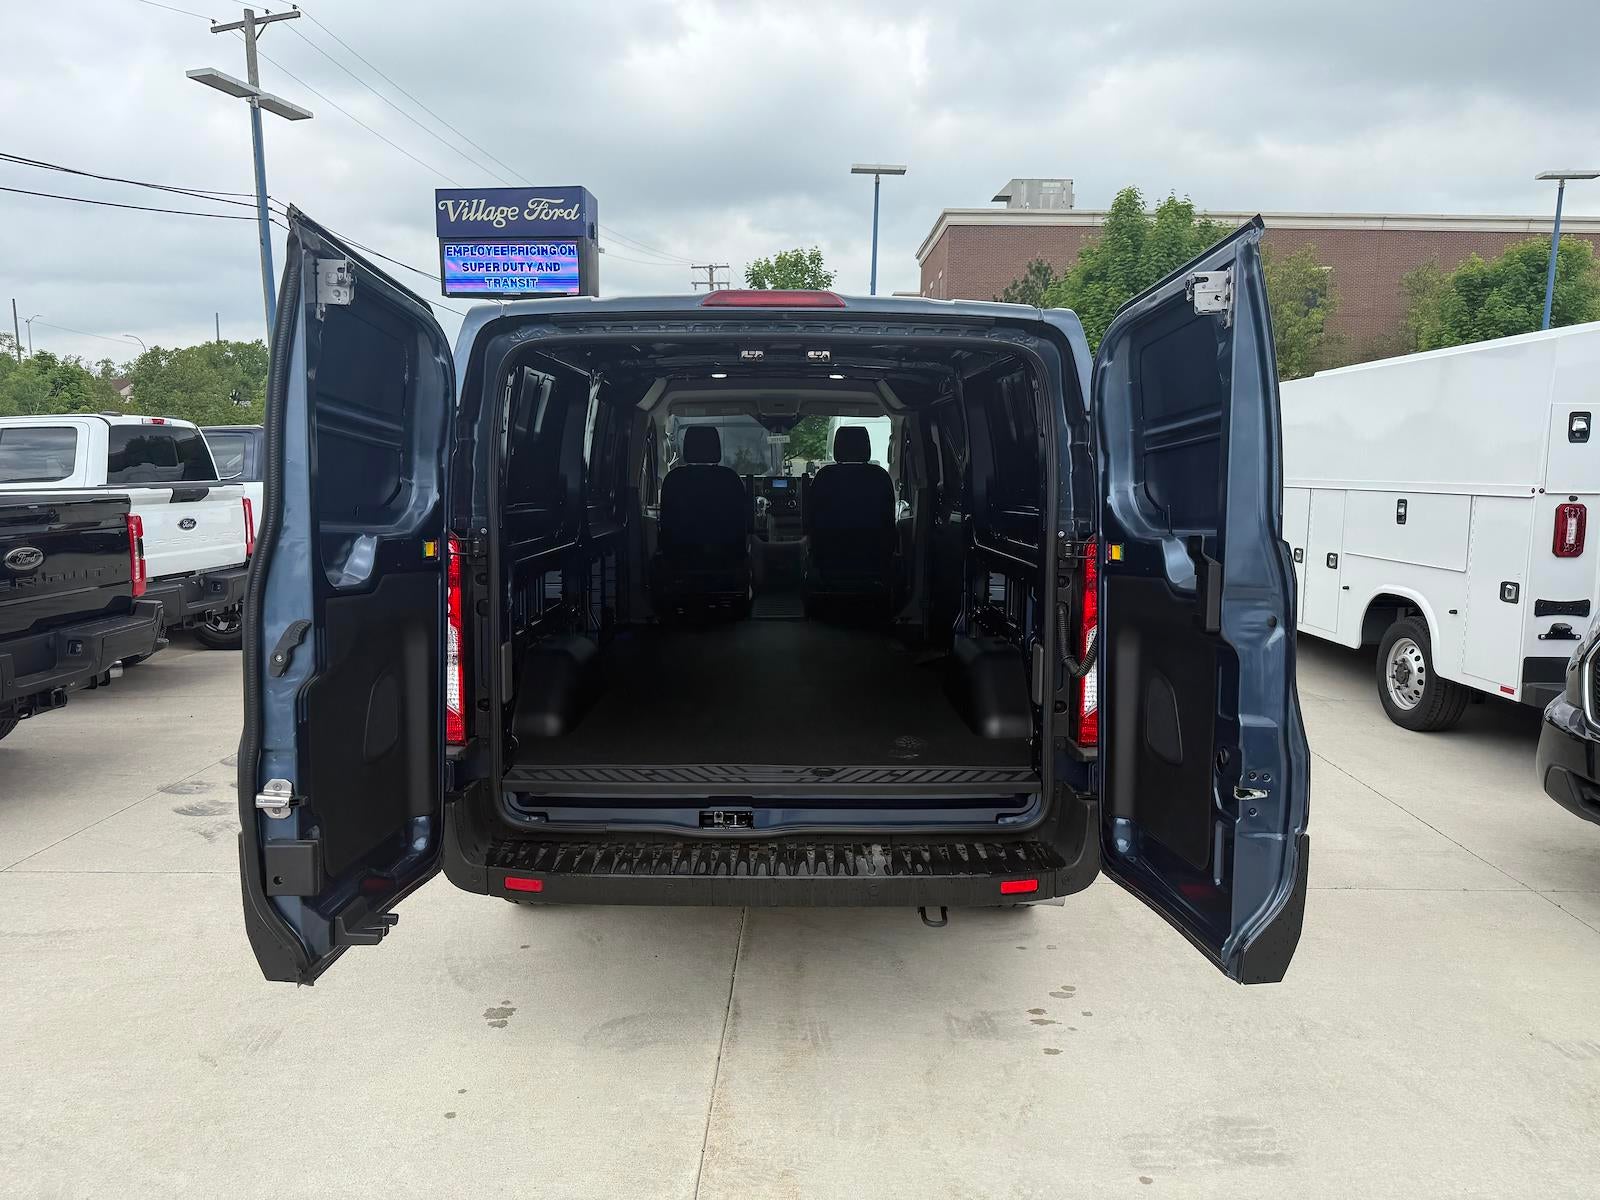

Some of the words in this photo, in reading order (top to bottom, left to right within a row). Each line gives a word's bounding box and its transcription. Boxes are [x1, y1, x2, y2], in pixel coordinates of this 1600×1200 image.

[438, 199, 519, 228] Village
[523, 197, 580, 221] Ford
[445, 245, 508, 257] EMPLOYEE
[510, 245, 556, 257] PRICING
[556, 245, 576, 256] ON
[462, 262, 500, 273] SUPER
[502, 262, 534, 273] DUTY
[536, 262, 561, 273] AND
[485, 278, 538, 288] TRANSIT
